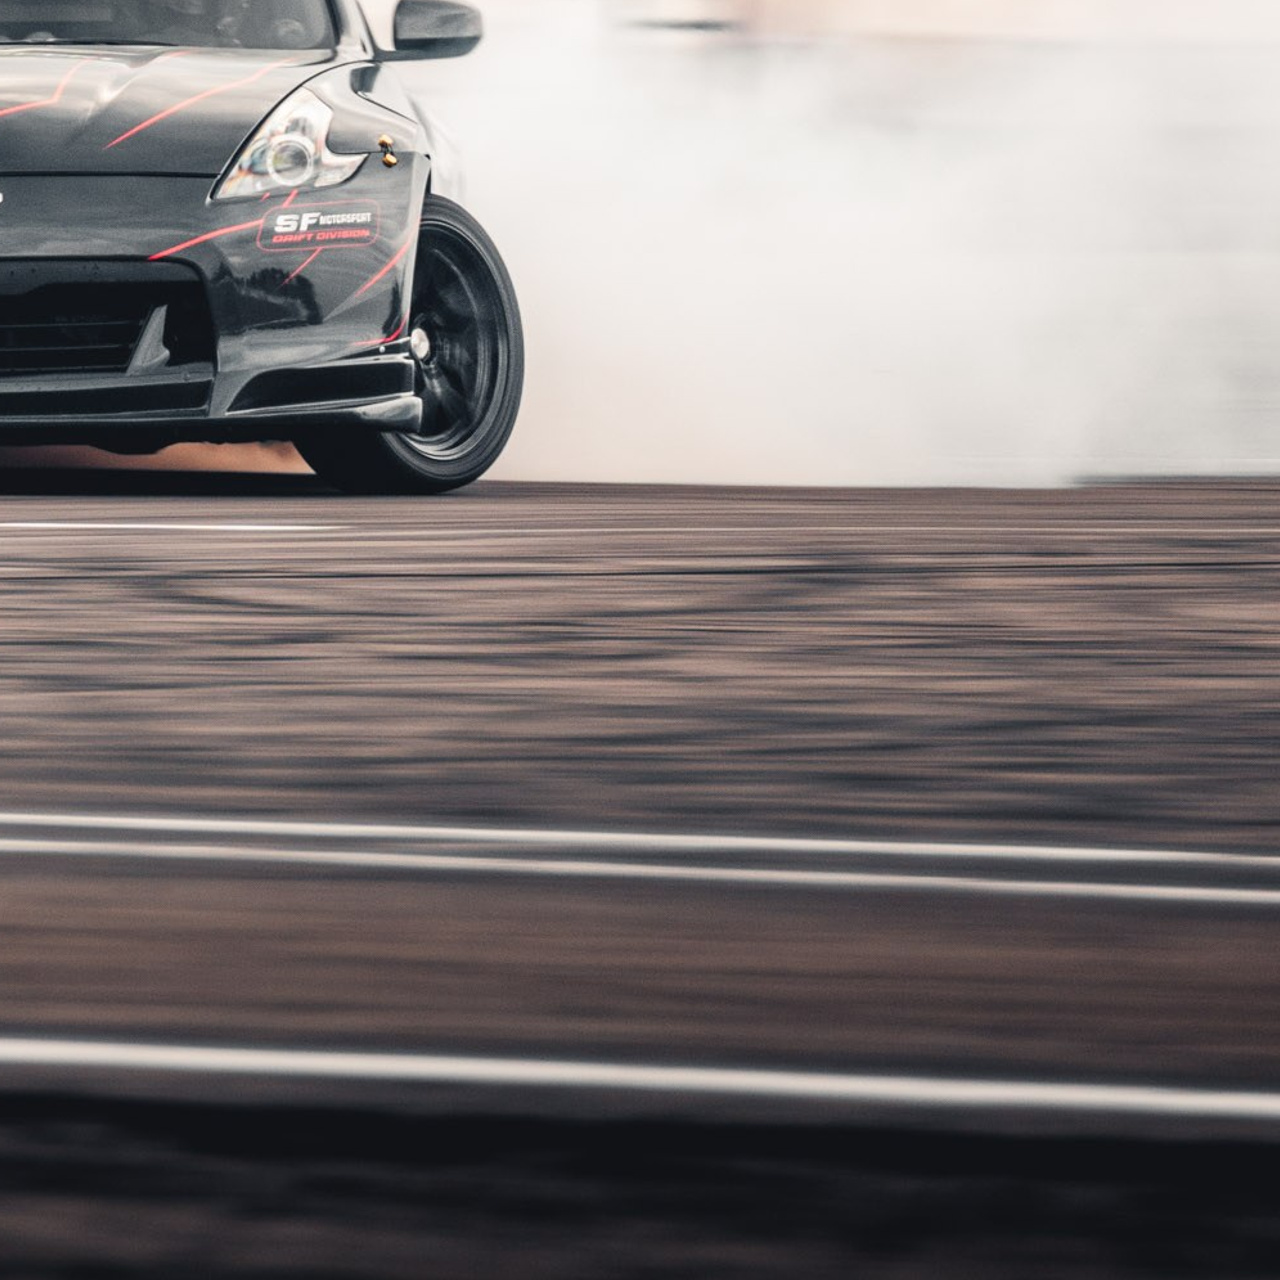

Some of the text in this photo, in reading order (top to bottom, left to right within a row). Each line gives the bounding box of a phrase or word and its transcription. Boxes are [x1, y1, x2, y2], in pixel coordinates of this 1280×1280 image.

[274, 212, 373, 233] SF MOTORSPORT
[272, 228, 370, 243] DRIFT DIVISION
